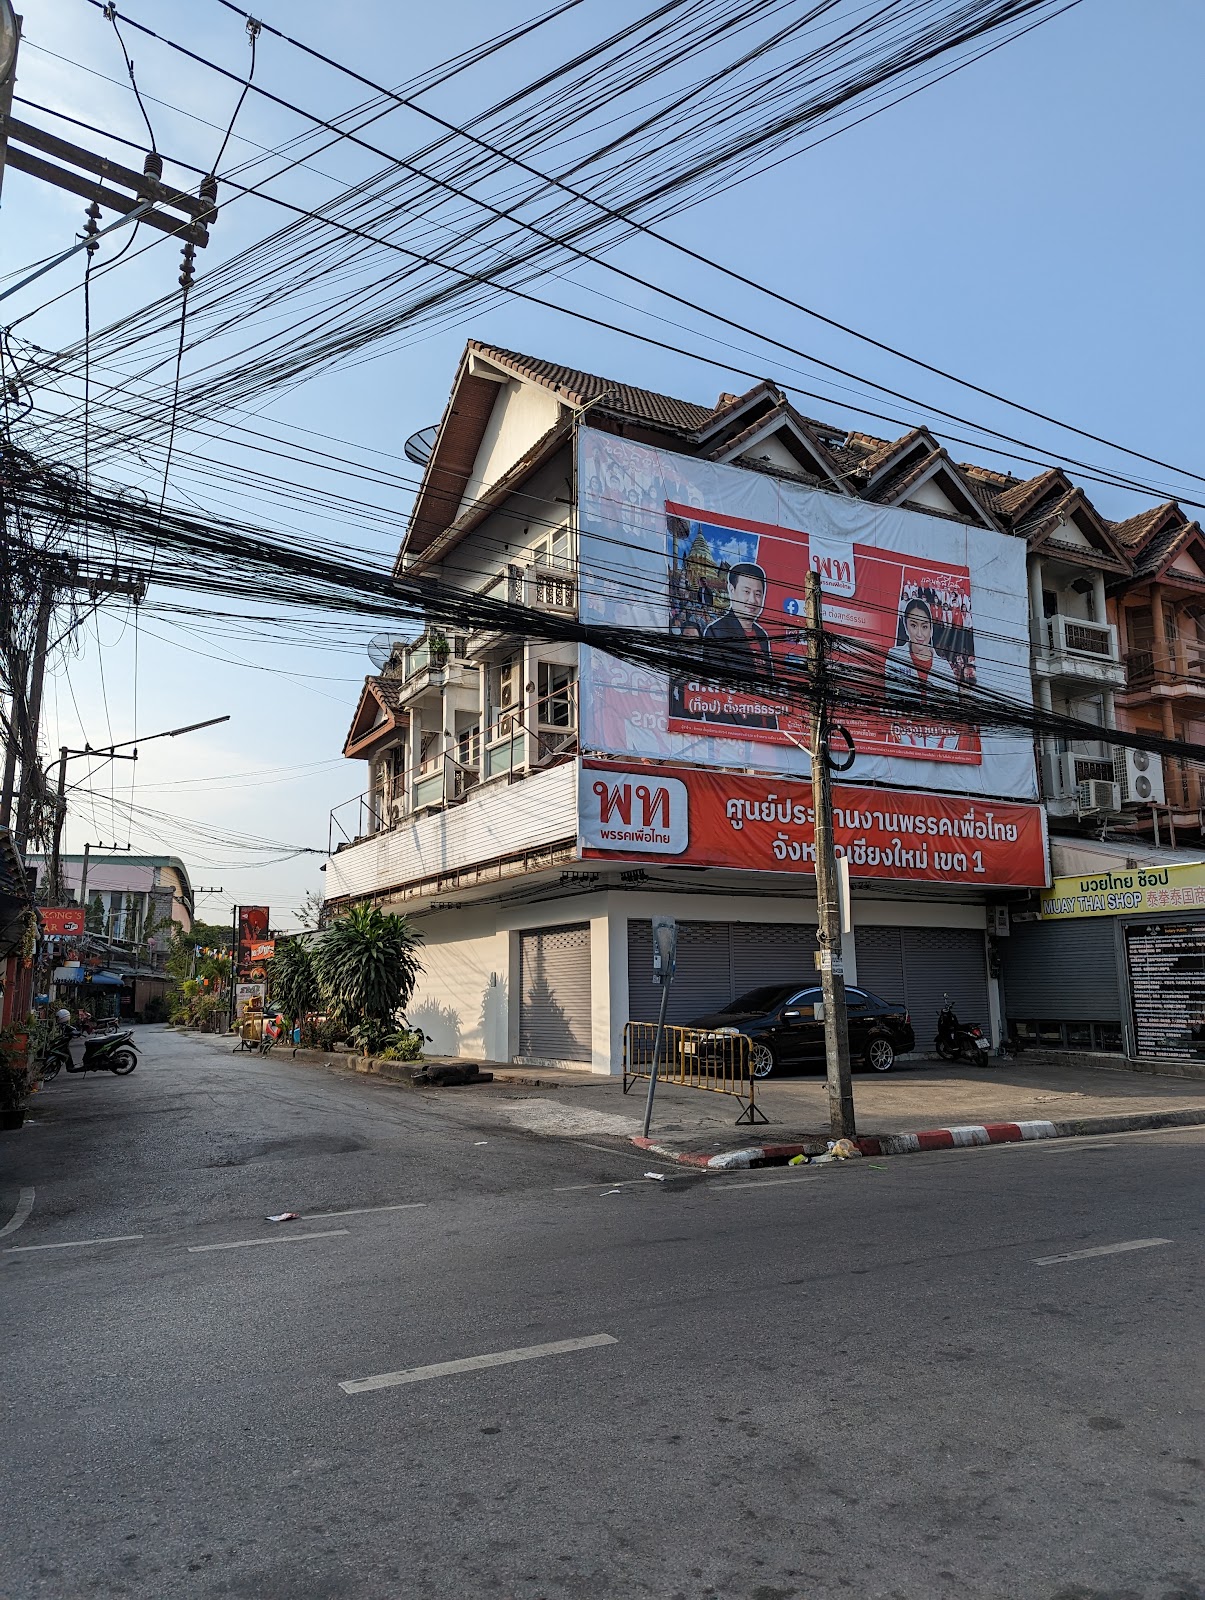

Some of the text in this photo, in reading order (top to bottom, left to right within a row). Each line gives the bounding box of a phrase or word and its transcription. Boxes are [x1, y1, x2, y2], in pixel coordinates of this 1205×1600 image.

[820, 581, 852, 590] รรคเพื่อไทย
[593, 781, 670, 829] พท
[726, 794, 1018, 842] ศูนย์ประานงานพรรคเพื่อไทย
[600, 828, 671, 844] พรรคเพื่อไทย
[772, 832, 986, 873] จังหดเชียงใหม่ เขต 1
[1080, 873, 1134, 893] มวยไทย
[1043, 891, 1142, 915] MUAY THAI SHOP
